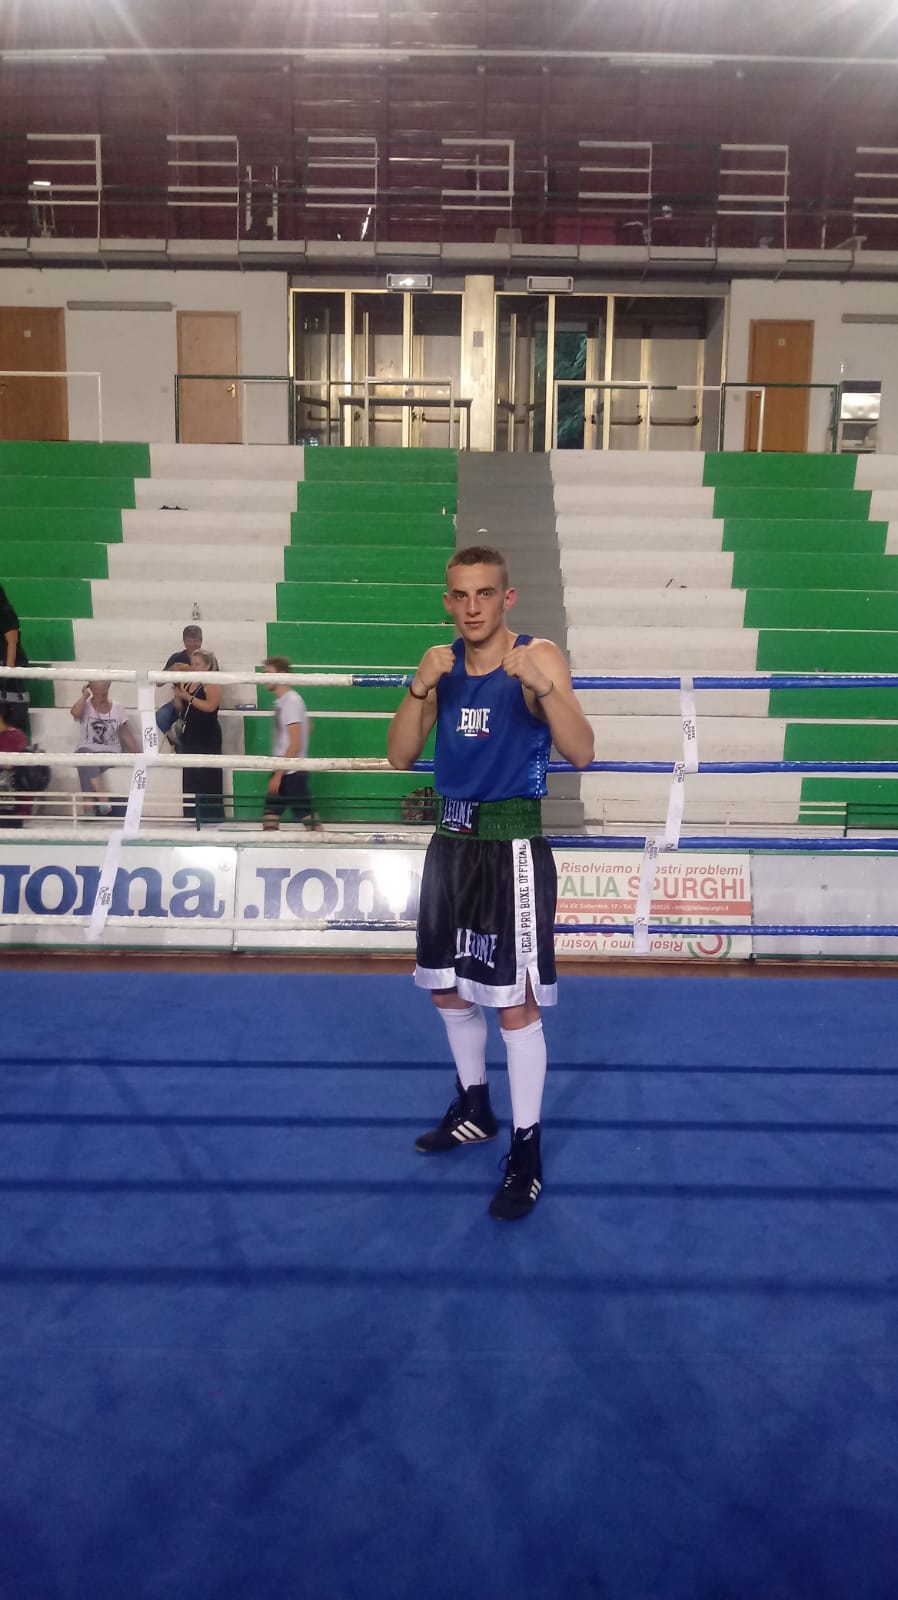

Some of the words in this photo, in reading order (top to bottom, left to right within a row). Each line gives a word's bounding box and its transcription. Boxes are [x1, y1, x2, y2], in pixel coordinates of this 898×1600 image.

[518, 843, 528, 884] OFFICIAL
[560, 862, 633, 874] Risolviamo
[655, 864, 682, 875] ostri
[685, 864, 744, 877] problemi
[520, 886, 530, 909] BOXE
[557, 875, 621, 898] ALIA
[628, 876, 745, 900] SURGHI
[521, 911, 531, 928] PRO
[455, 928, 498, 968] LEONE
[522, 931, 532, 953] LEGA
[561, 939, 598, 951] Vostri
